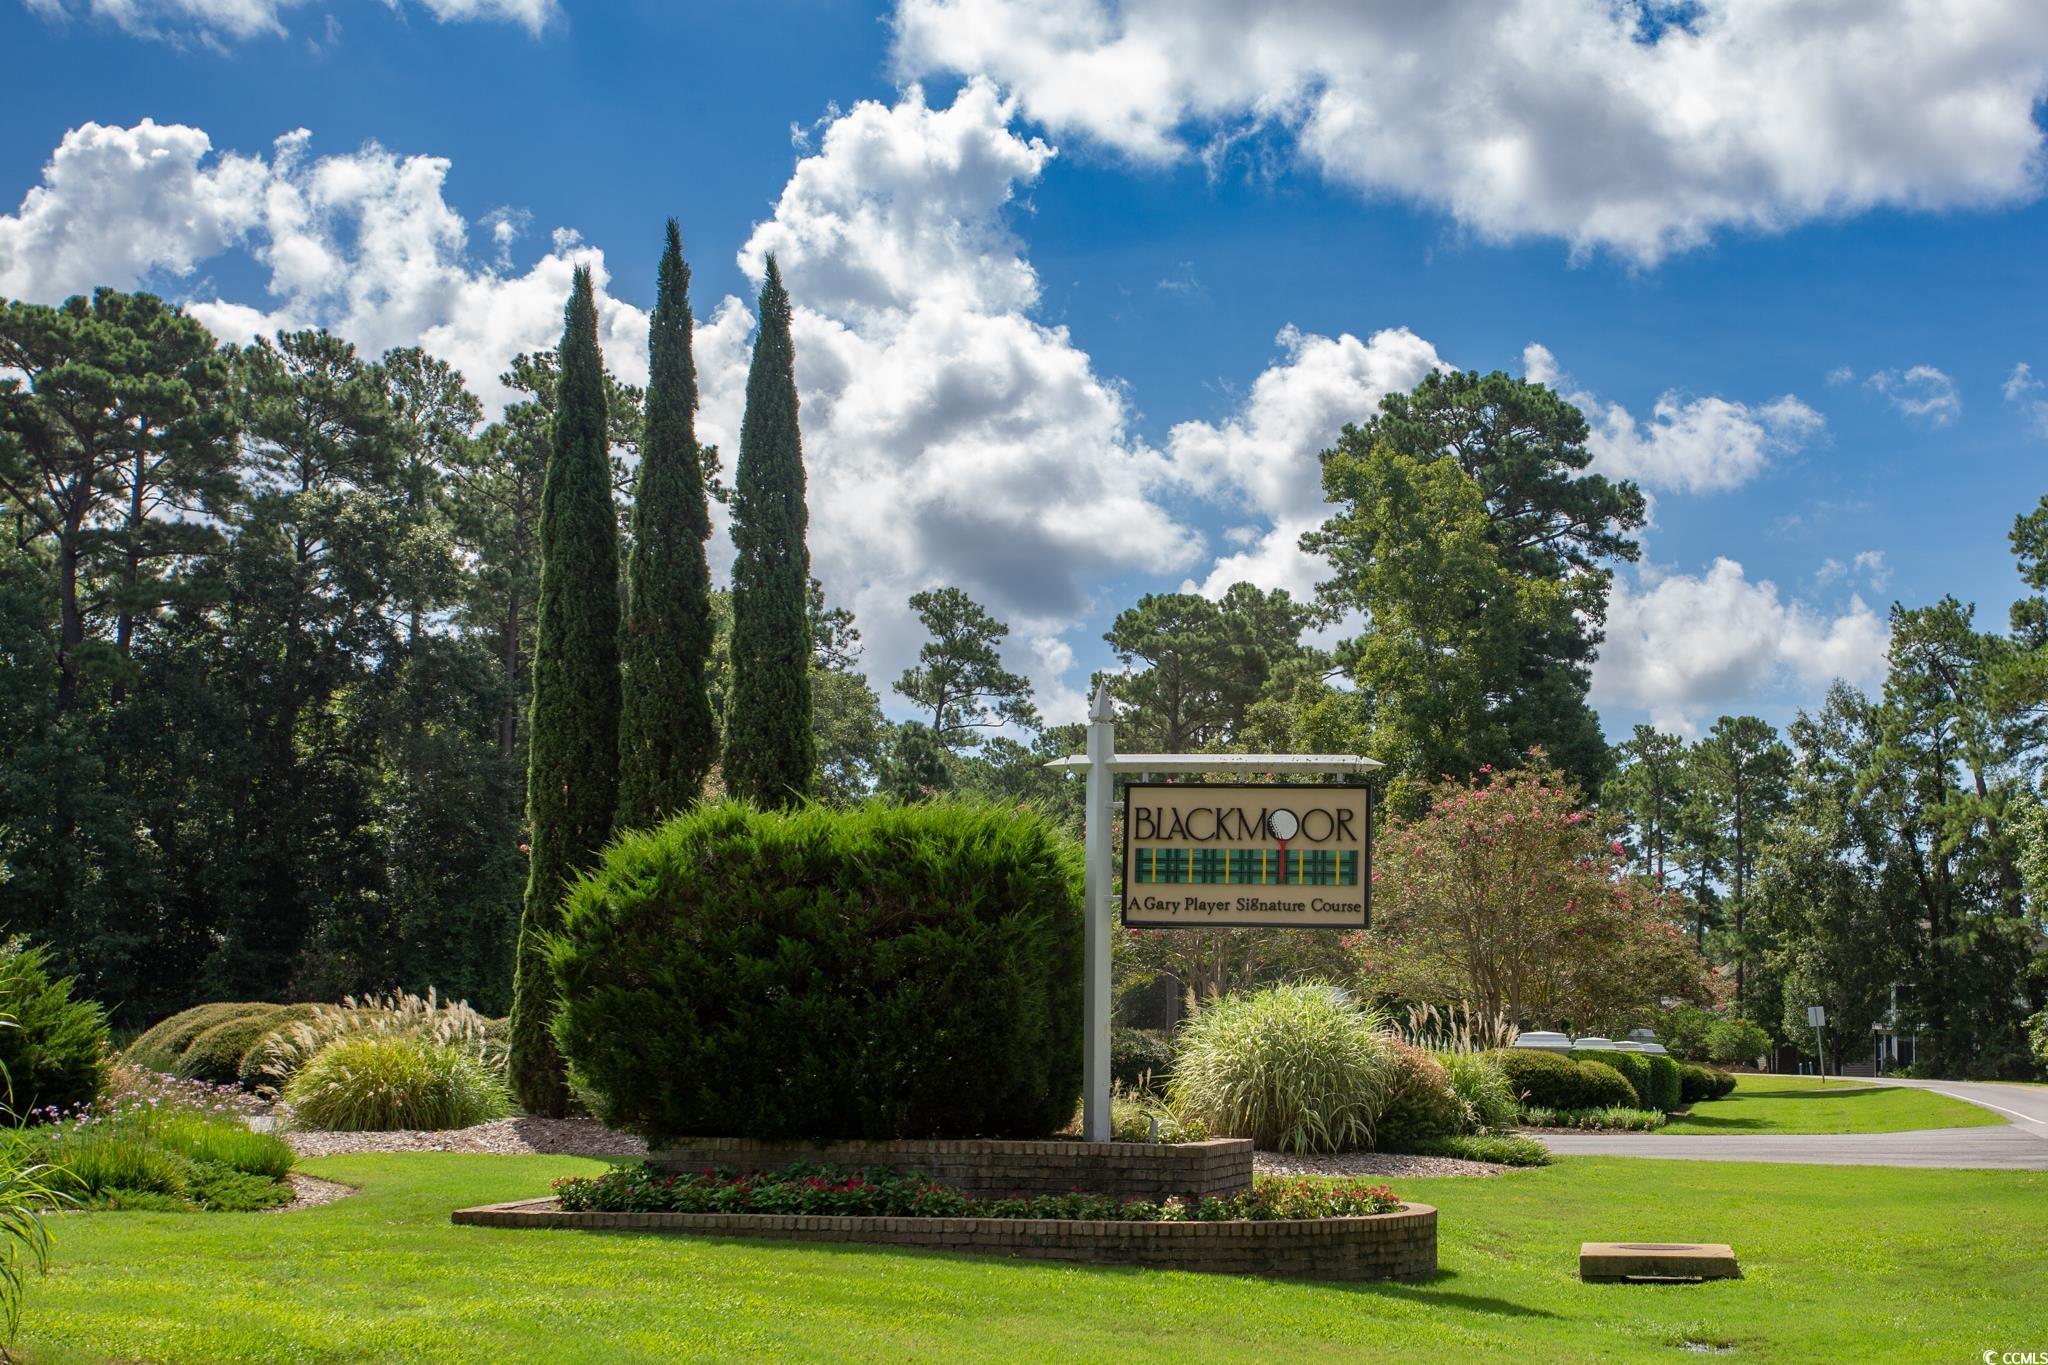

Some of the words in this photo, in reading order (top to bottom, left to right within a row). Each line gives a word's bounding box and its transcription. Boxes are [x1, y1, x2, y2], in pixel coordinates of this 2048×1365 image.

[1134, 807, 1357, 842] BLACKMOOR
[1128, 898, 1142, 911] A
[1144, 897, 1181, 915] Gary
[1184, 897, 1230, 915] Player
[1236, 897, 1306, 913] Signature
[1311, 898, 1362, 913] Course
